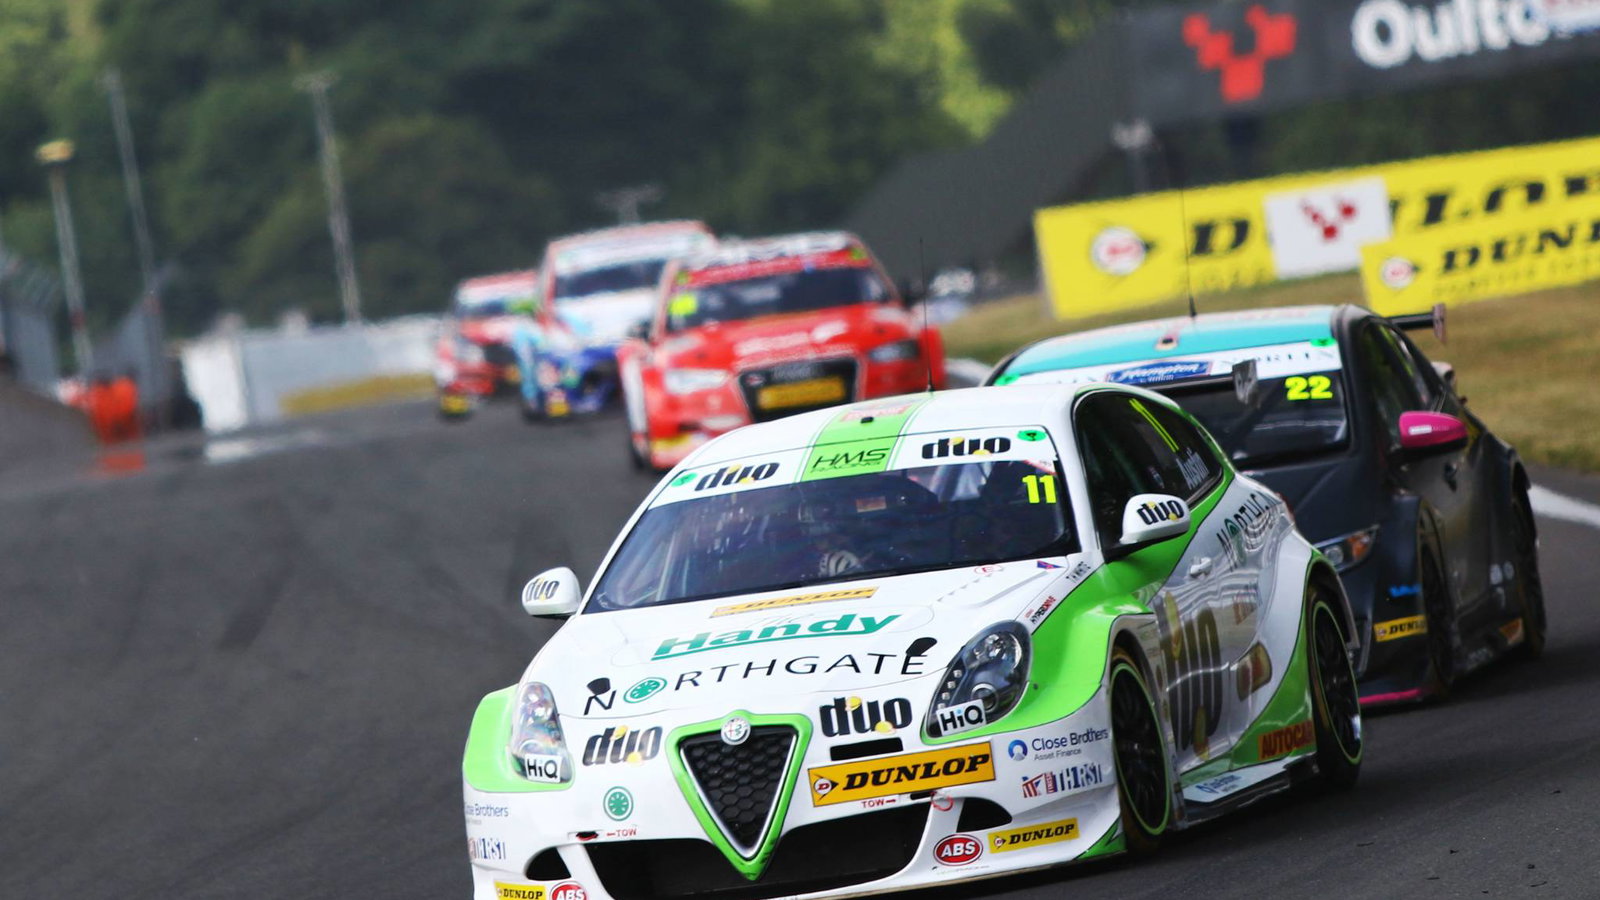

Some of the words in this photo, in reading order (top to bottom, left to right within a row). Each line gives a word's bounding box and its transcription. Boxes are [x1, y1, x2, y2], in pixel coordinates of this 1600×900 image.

[1351, 0, 1572, 69] Oulto
[1285, 375, 1334, 401] 22
[812, 447, 890, 469] HMS
[922, 436, 1011, 459] duo
[695, 462, 780, 491] duo
[1022, 474, 1057, 504] 11
[1136, 499, 1185, 525] duo
[525, 577, 560, 602] duo
[651, 613, 902, 661] Handy
[583, 652, 928, 716] NORTHGATE
[819, 696, 913, 738] duo
[940, 705, 984, 732] HiQ
[582, 725, 663, 767] duo
[1032, 738, 1068, 751] Close
[1069, 728, 1109, 746] Brothers
[1034, 752, 1055, 761] Asset
[1056, 748, 1082, 758] Finance
[527, 758, 558, 779] HiQ
[842, 753, 990, 791] DUNLOP
[475, 803, 509, 818] Brothers
[862, 799, 886, 808] TOW
[616, 828, 637, 839] TOW
[1008, 823, 1075, 846] DUNLOP
[940, 842, 976, 860] ABS
[503, 888, 544, 900] DUNLOP
[556, 889, 585, 900] ABS
